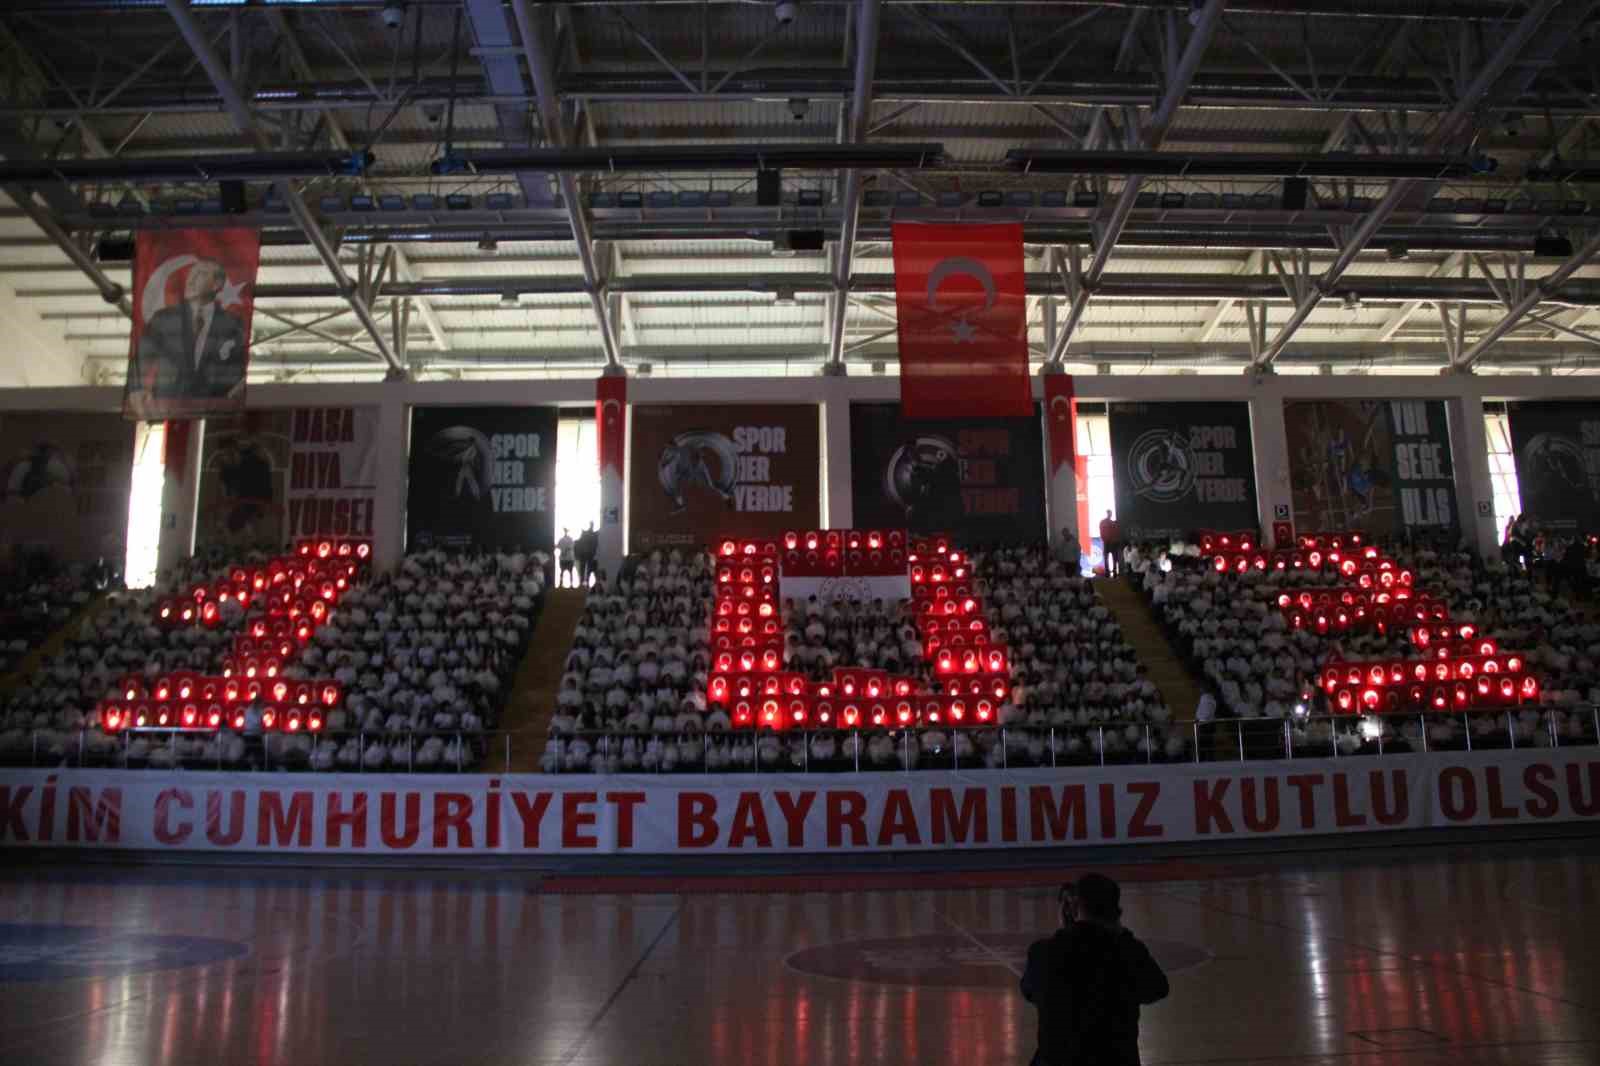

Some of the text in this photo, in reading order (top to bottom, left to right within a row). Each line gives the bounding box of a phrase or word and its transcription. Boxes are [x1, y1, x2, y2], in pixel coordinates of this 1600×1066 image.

[489, 432, 541, 458] SPOR
[732, 426, 786, 453] SPOR
[1190, 425, 1237, 449] SPOR
[733, 485, 793, 512] YERDE
[0, 761, 1600, 850] KİM CUMHURİYET BAYRAMIMIZ KUTLU OLSU
